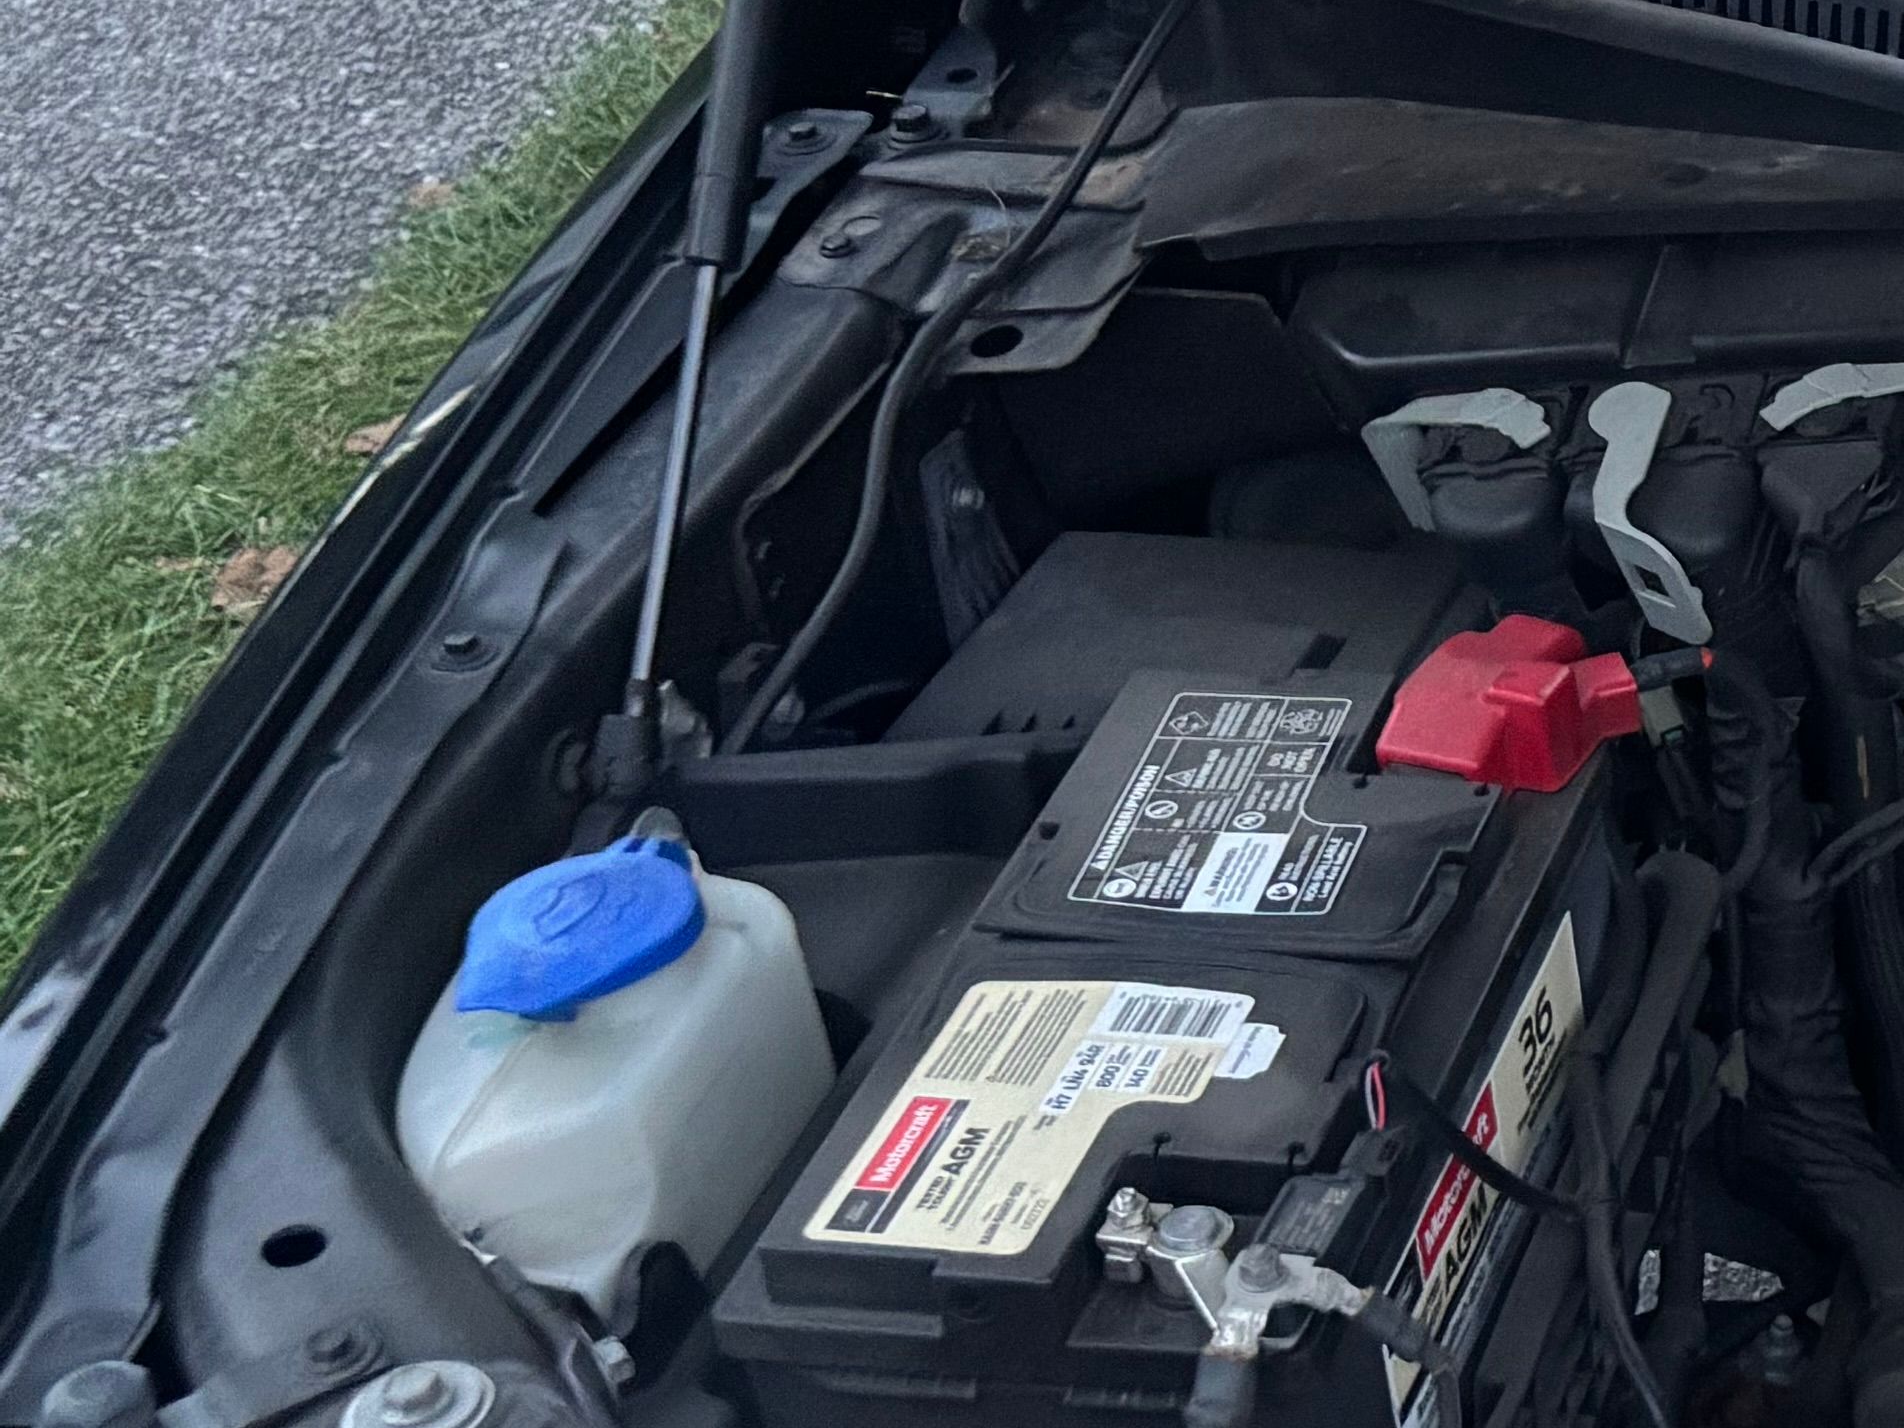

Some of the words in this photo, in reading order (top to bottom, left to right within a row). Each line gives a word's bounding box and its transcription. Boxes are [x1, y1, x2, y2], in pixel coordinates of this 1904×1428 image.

[1518, 985, 1554, 1079] 36
[869, 1104, 938, 1183] Motorcraft
[943, 1127, 990, 1177] AGM
[1444, 1182, 1489, 1295] AGM
